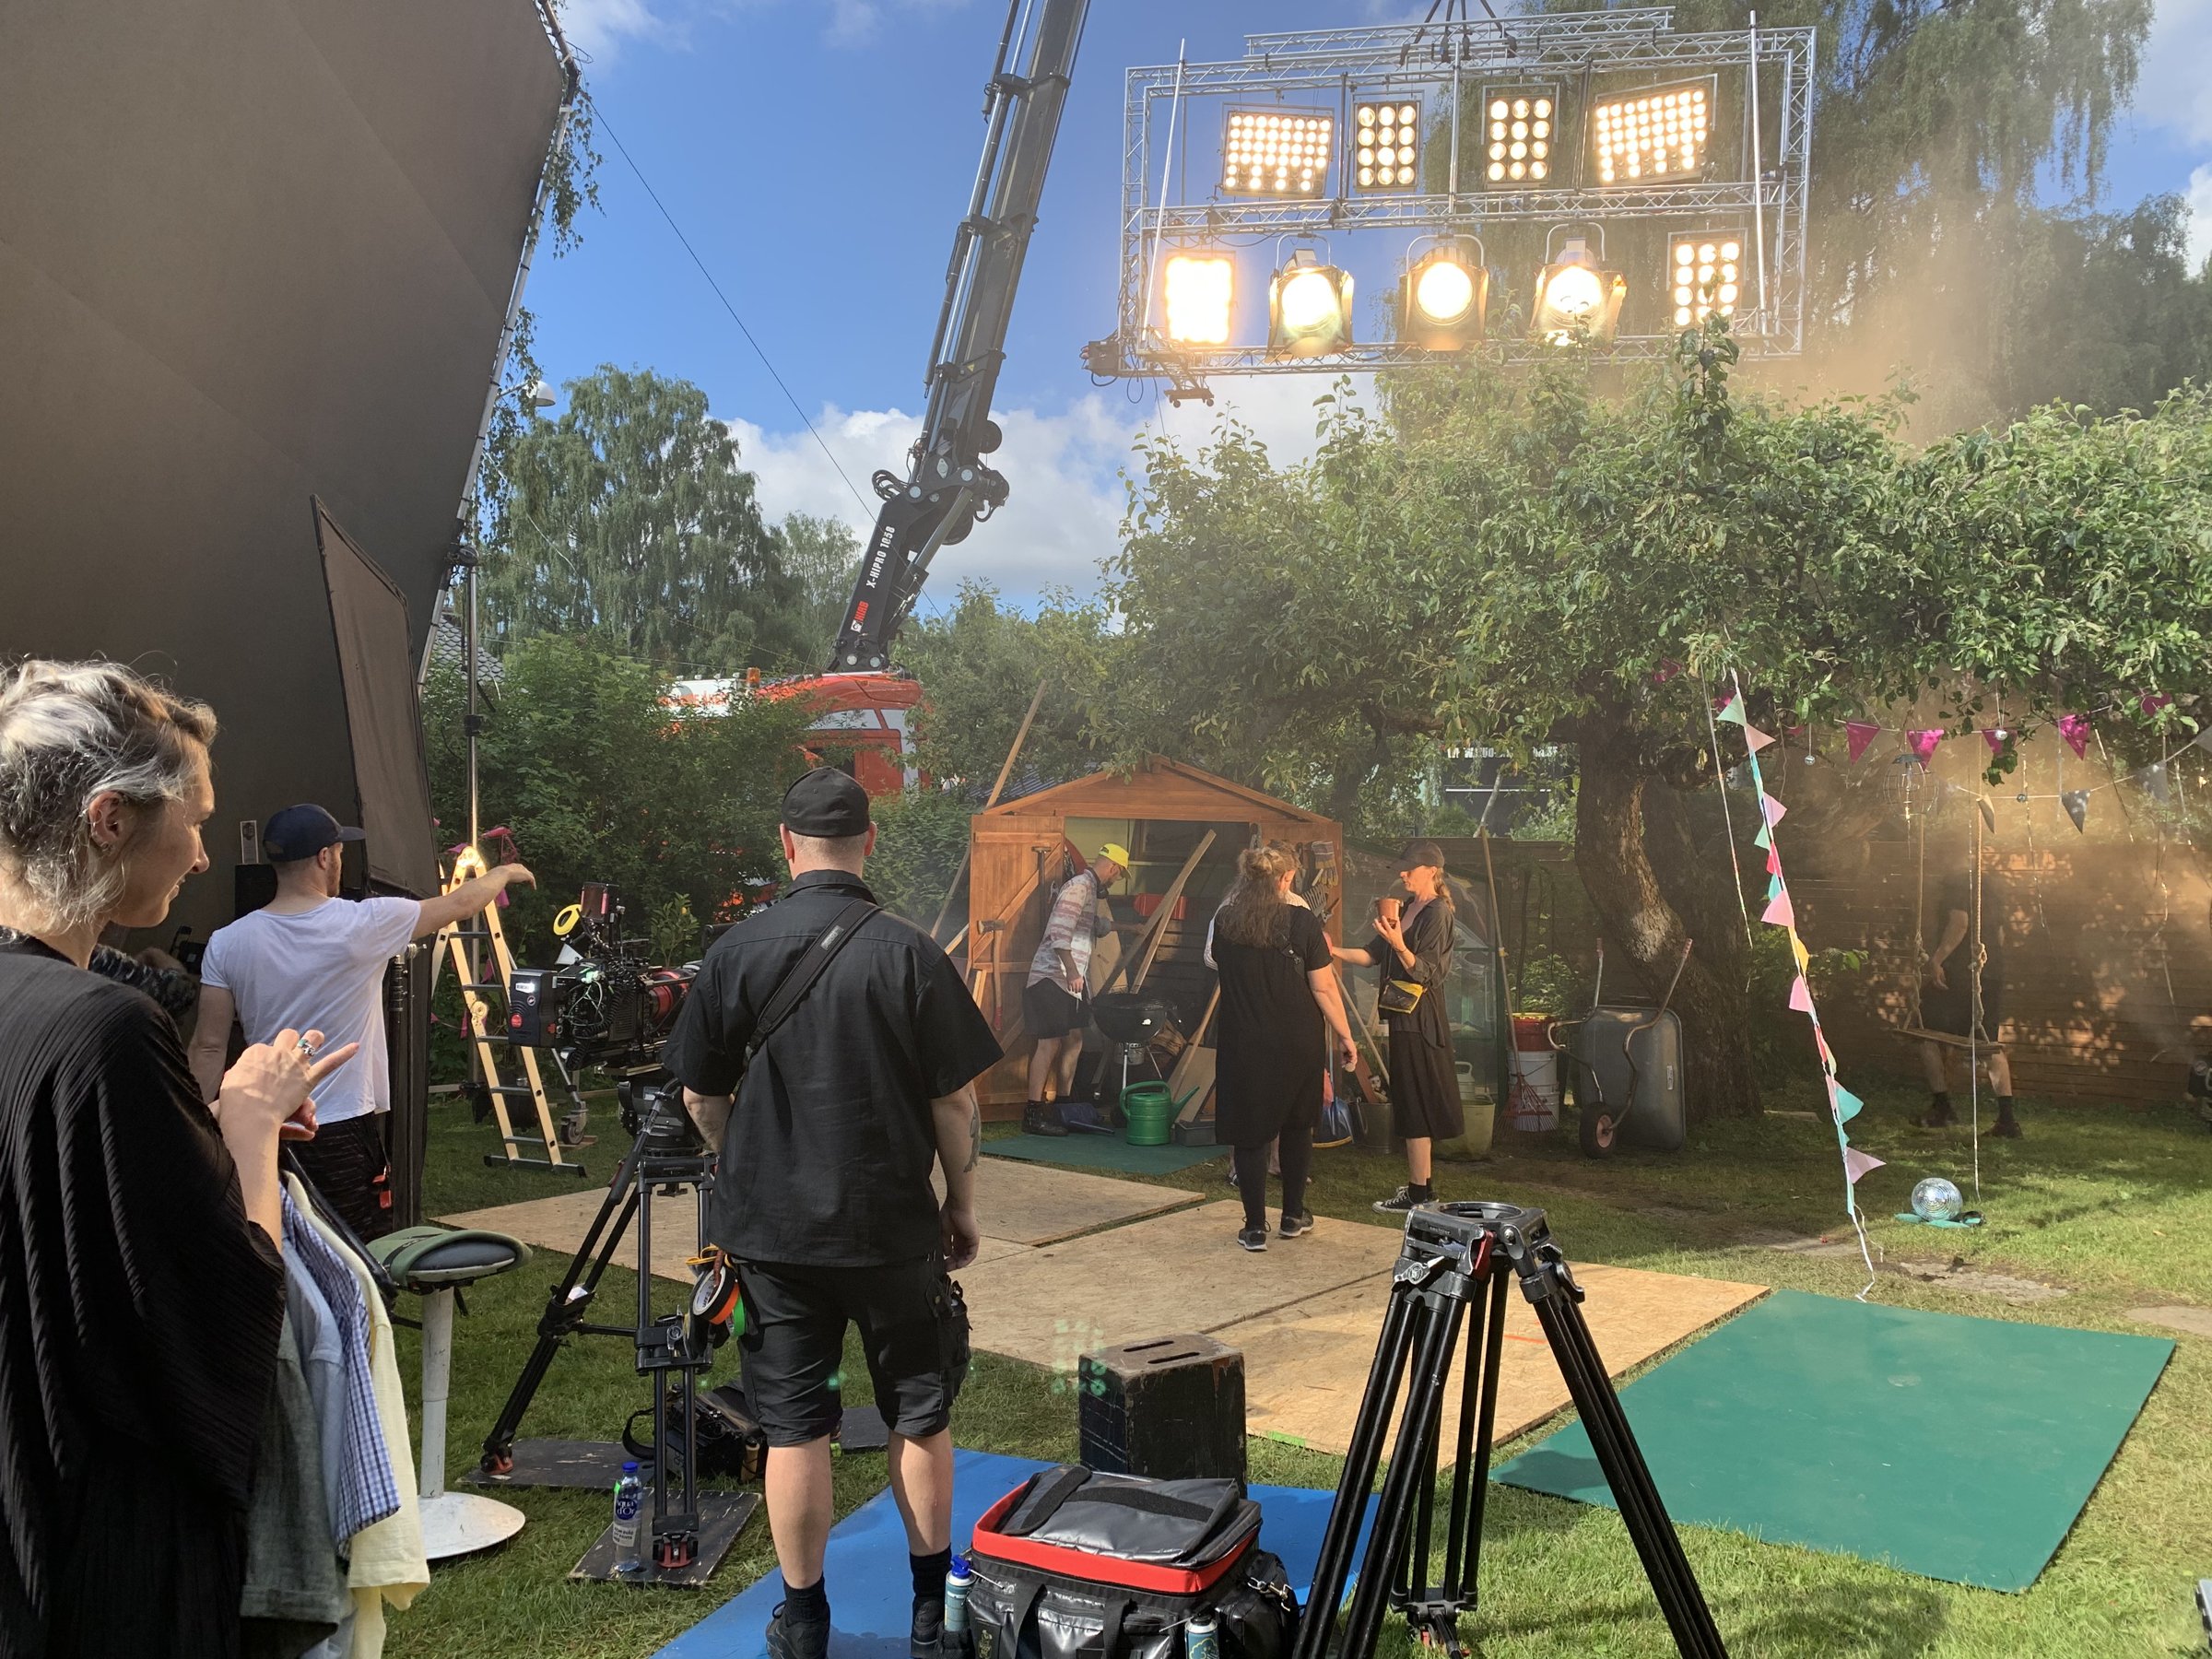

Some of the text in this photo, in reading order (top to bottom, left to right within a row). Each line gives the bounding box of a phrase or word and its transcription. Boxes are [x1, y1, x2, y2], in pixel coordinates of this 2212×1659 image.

[865, 525, 896, 589] X-HIPRO 1058
[853, 600, 869, 624] HIAB
